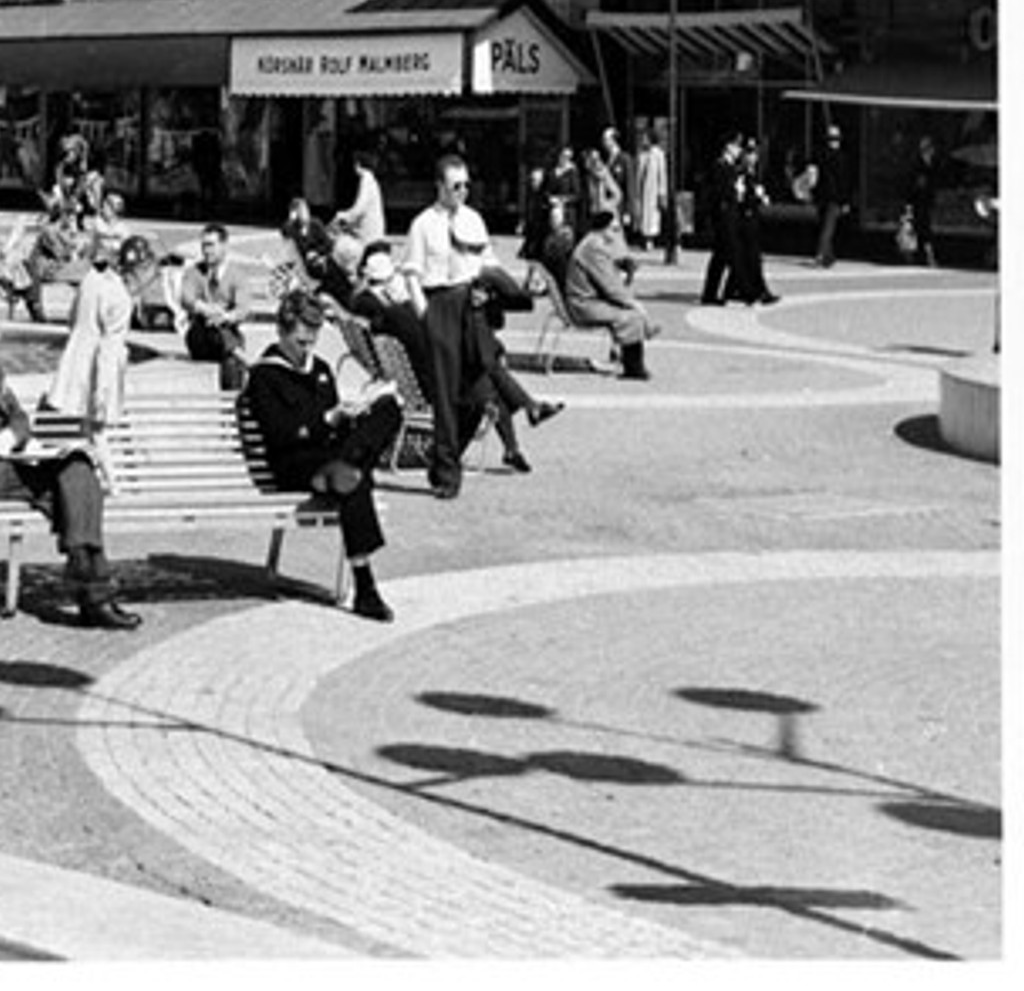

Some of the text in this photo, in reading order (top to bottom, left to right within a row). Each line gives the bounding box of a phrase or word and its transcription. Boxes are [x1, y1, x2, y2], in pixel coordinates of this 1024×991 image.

[320, 54, 352, 75] ROLF
[359, 52, 432, 74] MALMBERG
[491, 38, 540, 74] PÄLS
